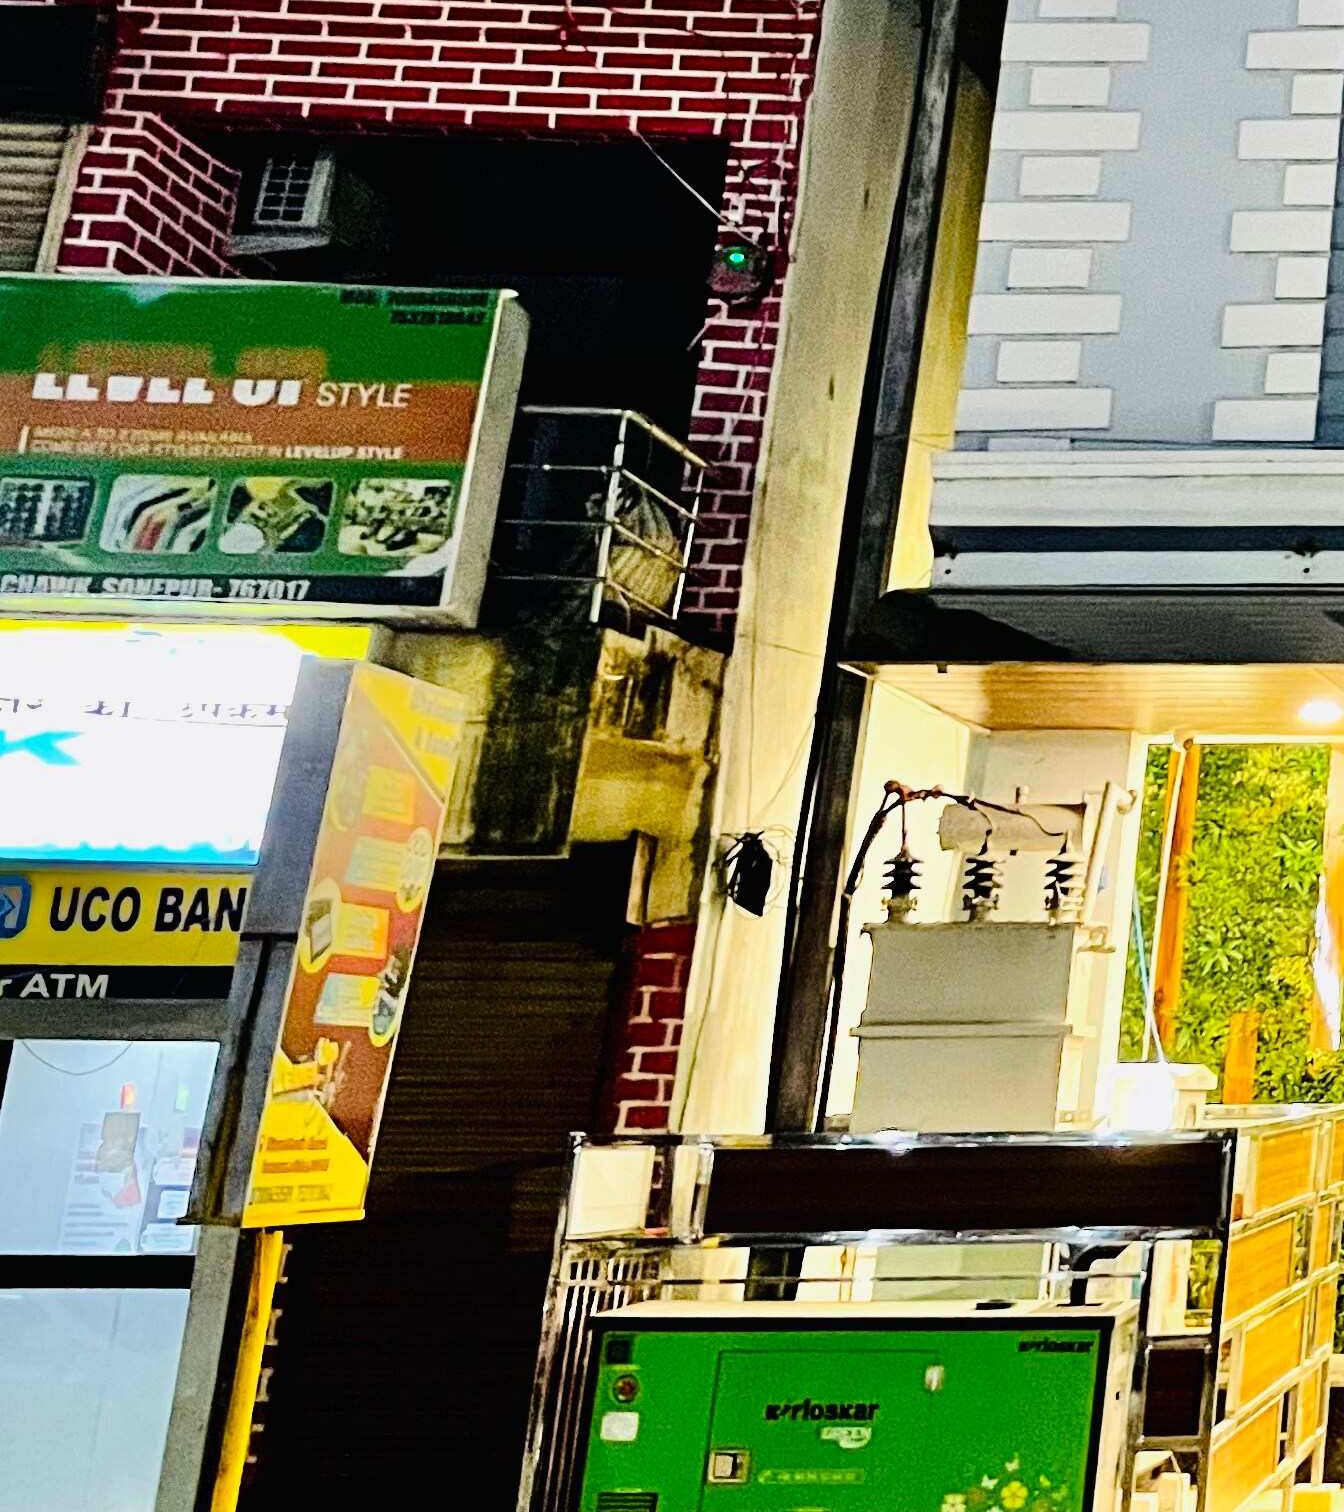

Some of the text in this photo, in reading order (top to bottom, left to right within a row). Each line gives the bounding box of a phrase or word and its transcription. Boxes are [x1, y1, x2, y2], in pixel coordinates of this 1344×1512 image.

[316, 382, 412, 408] STYLE
[50, 886, 247, 932] UCO BAN
[19, 973, 109, 998] ATM
